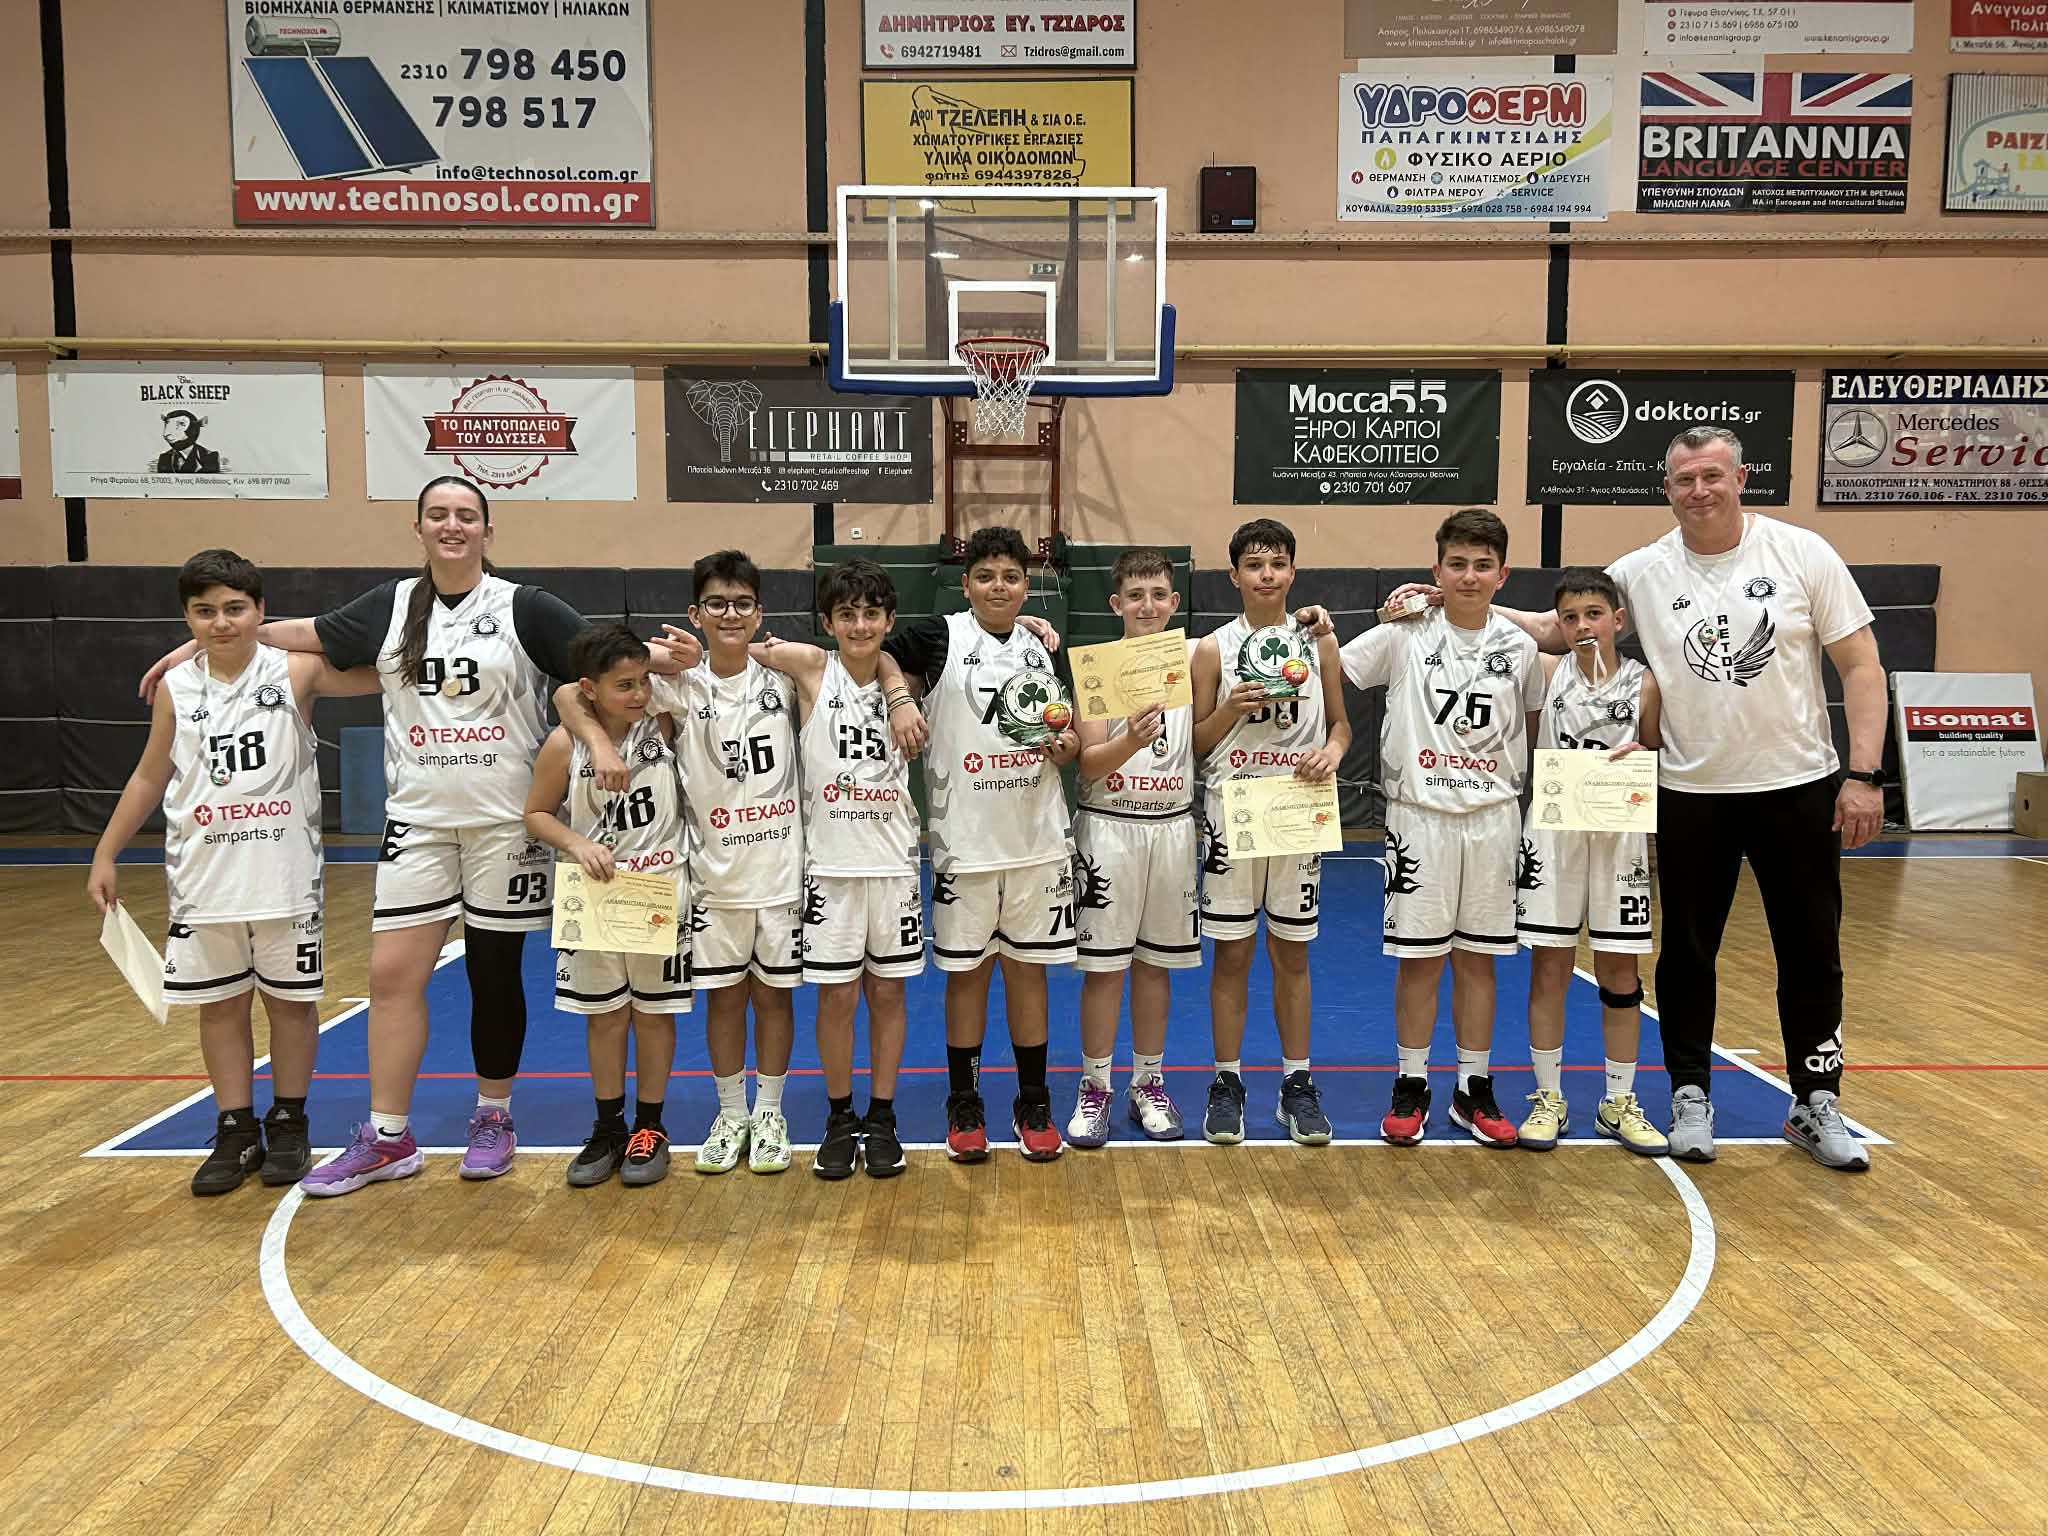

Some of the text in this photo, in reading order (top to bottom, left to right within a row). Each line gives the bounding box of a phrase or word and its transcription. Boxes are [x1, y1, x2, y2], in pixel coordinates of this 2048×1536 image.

[245, 1, 629, 17] ΒΙΟΜΗΧΑΝΙΑ ΘΕΡΜΑΝΣΗΣ ΚΛΙΜΑΤΙΣΜΟΥ ΗΛΙΑΚΩΝ
[879, 15, 1125, 32] ΔΗΜΗΤΡΙΟΣ ΕΥ. ΤΖΙΔΡΟΣ
[1680, 20, 1700, 29] 2310
[901, 45, 1125, 59] 6942719481 Tzidros@gmail.com
[401, 48, 627, 83] 2310 798 450
[432, 96, 597, 129] 798 517
[1354, 83, 1586, 128] ΥΔΡΟΘΕΡΜ
[937, 109, 1086, 127] ΤΖΕΛΕΠΗ & ΣΙΑ Ο.Ε.
[913, 133, 1083, 146] ΧΩΜΑΤΟΥΡΓΙΚΕΣ ΕΡΓΑΣΙΕΣ
[1361, 131, 1582, 144] ΠΑΠΑΓΚΙΝΤΣΙΔΗΣ
[1642, 125, 1905, 159] BRITANNIA
[924, 151, 1074, 165] ΥΛΙΚΑ ΟΙΚΟΔΟΜΩΝ
[1407, 151, 1567, 167] ΦΥΣΙΚΟ ΑΕΡΙΟ
[435, 165, 639, 184] info@technosol.com.gr
[974, 169, 1072, 180] 6944397826
[1641, 160, 1905, 177] LANGUAGE CENTER
[1368, 173, 1590, 183] ΘΕΡΜΑΝΣΗ ΚΛΙΜΑΤΙΣΜΟΣ ΥΔΡΕΥΣΗ
[1404, 188, 1484, 197] ΦΙΛΤΡΑ ΝΕΡΟΥ
[1511, 188, 1554, 197] SERVICE
[1641, 187, 1744, 197] ΥΠΕΥΘΥΝΗ ΣΠΟΥΔΩΝ
[254, 185, 640, 220] www.technosol.com.gr
[1395, 204, 1592, 213] 23910 53353 6974 028 758 6984 194 994
[1653, 199, 1731, 209] ΜΗΛΙΩΝΗ ΛΙΑΝΑ
[1775, 199, 1811, 208] European
[1813, 199, 1826, 207] and
[1828, 199, 1875, 207] Intercultural
[1877, 199, 1905, 207] Studies
[140, 385, 231, 401] BLACK SHEEP
[1831, 375, 2048, 399] ΕΛΕΥΘΕΡΙΑΔΗΣ
[1634, 400, 1762, 424] doktoris.gr
[441, 419, 560, 431] ΤΟ ΠΑΝΤΟΠΩΛΕΙΟ
[1294, 416, 1441, 439] ΞΗΡΟΙ ΚΑΡΠΟΙ
[1896, 413, 2000, 431] Mercedes
[750, 411, 907, 450] ELEPHANT
[456, 433, 546, 445] ΤΟΥ ΟΔΥΣΣΕΑ
[845, 453, 880, 461] COFFEE
[1293, 441, 1440, 464] ΚΑΦΕΚΟΠΤΕΙΟ
[884, 467, 913, 475] Elephant
[1552, 459, 1606, 472] Εργαλεία
[1616, 460, 1647, 472] Σπίτι
[774, 480, 839, 491] 2310 702 469
[1333, 481, 1412, 494] 2310 701 607
[1836, 478, 1906, 488] ΚΟΛΟΚΟΤΡΩΝΗ
[1908, 478, 1919, 488] 12
[1933, 478, 1998, 488] ΜΟΝΑΣΤΗΡΙΟΥ
[2000, 478, 2011, 488] 88
[1834, 491, 1861, 500] ΤΗΛ.
[1864, 491, 1894, 500] 2310
[1897, 491, 1945, 500] 760.106
[1955, 491, 1981, 500] FAX.
[1984, 491, 2014, 500] 2310
[1672, 600, 1691, 611] CAP
[963, 656, 981, 666] CAP
[1424, 656, 1443, 666] CAP
[416, 656, 481, 696] 93
[1433, 688, 1493, 730] 76
[1911, 710, 2027, 727] isomat
[429, 725, 506, 744] TEXACO
[1938, 731, 2004, 740] building quality
[418, 751, 499, 768] simparts.gr
[1922, 746, 1936, 759] for
[1948, 747, 1997, 757] sustainable
[2000, 746, 2026, 758] future
[1439, 752, 1498, 773] TEXACO
[1128, 775, 1184, 792] TEXACO
[1425, 774, 1497, 793] simparts.gr
[845, 786, 899, 802] TEXACO
[217, 800, 292, 821] TEXACO
[735, 799, 796, 824] TEXACO
[829, 807, 894, 824] simparts.gr
[204, 826, 287, 845] simparts.gr
[721, 824, 793, 847] simparts.gr
[507, 872, 547, 904] 93
[1620, 895, 1650, 926] 23
